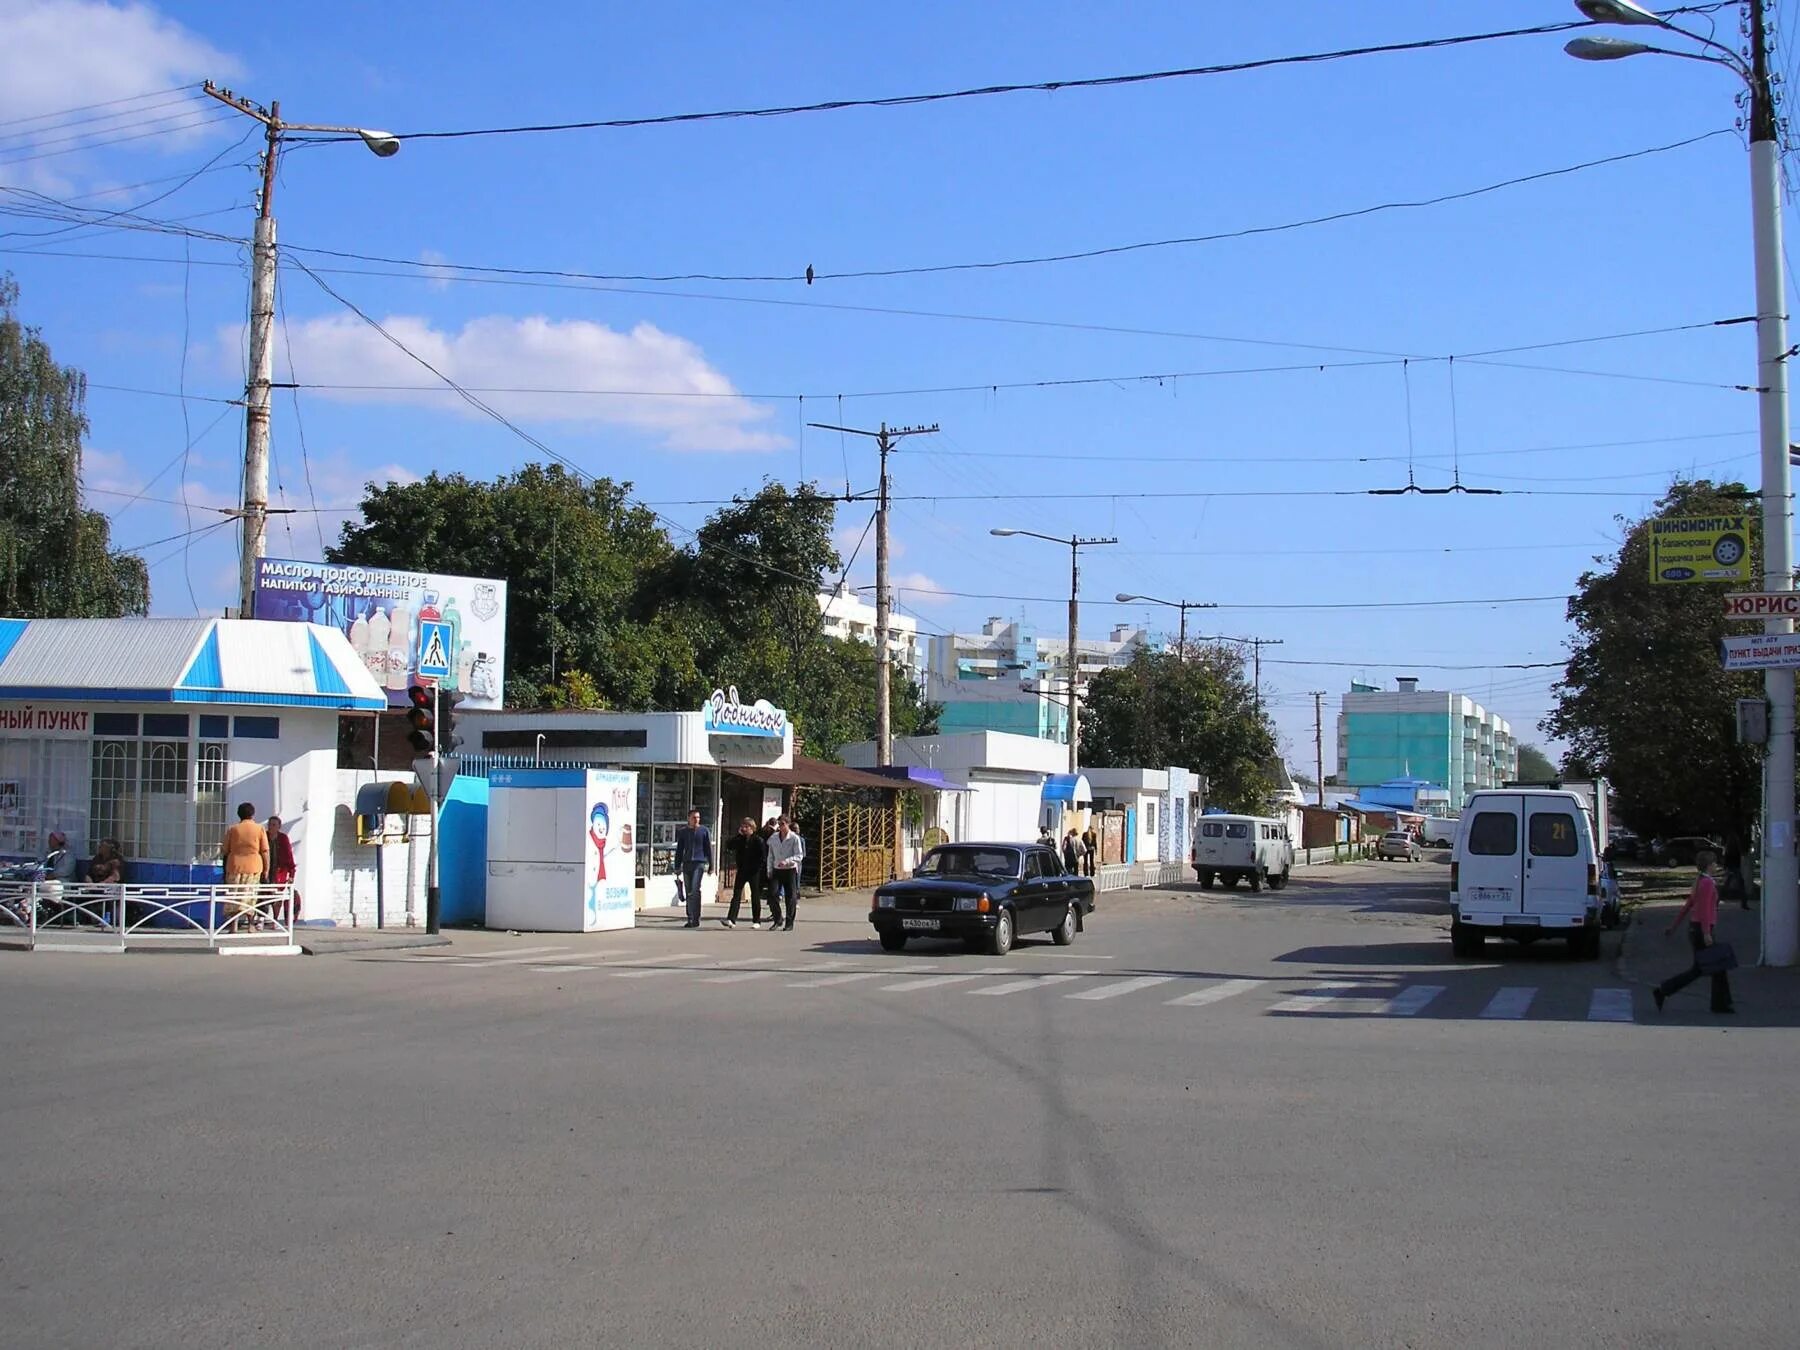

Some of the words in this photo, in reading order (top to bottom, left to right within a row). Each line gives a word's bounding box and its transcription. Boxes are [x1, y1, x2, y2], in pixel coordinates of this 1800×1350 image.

[1653, 517, 1744, 533] ШИНОМОНТАЖ
[261, 562, 315, 577] МАСЛО
[320, 567, 428, 589] ПОДСОЛНЕЧНОЕ
[261, 578, 317, 593] НАПИТКИ
[320, 582, 409, 601] ГАЗИРОВАННЫЕ
[1729, 648, 1751, 659] ПУНКТ
[1753, 646, 1781, 657] ВЫДАЧИ
[711, 685, 784, 730] Родничок
[37, 711, 89, 731] ПУНКТ
[1552, 822, 1566, 840] 21
